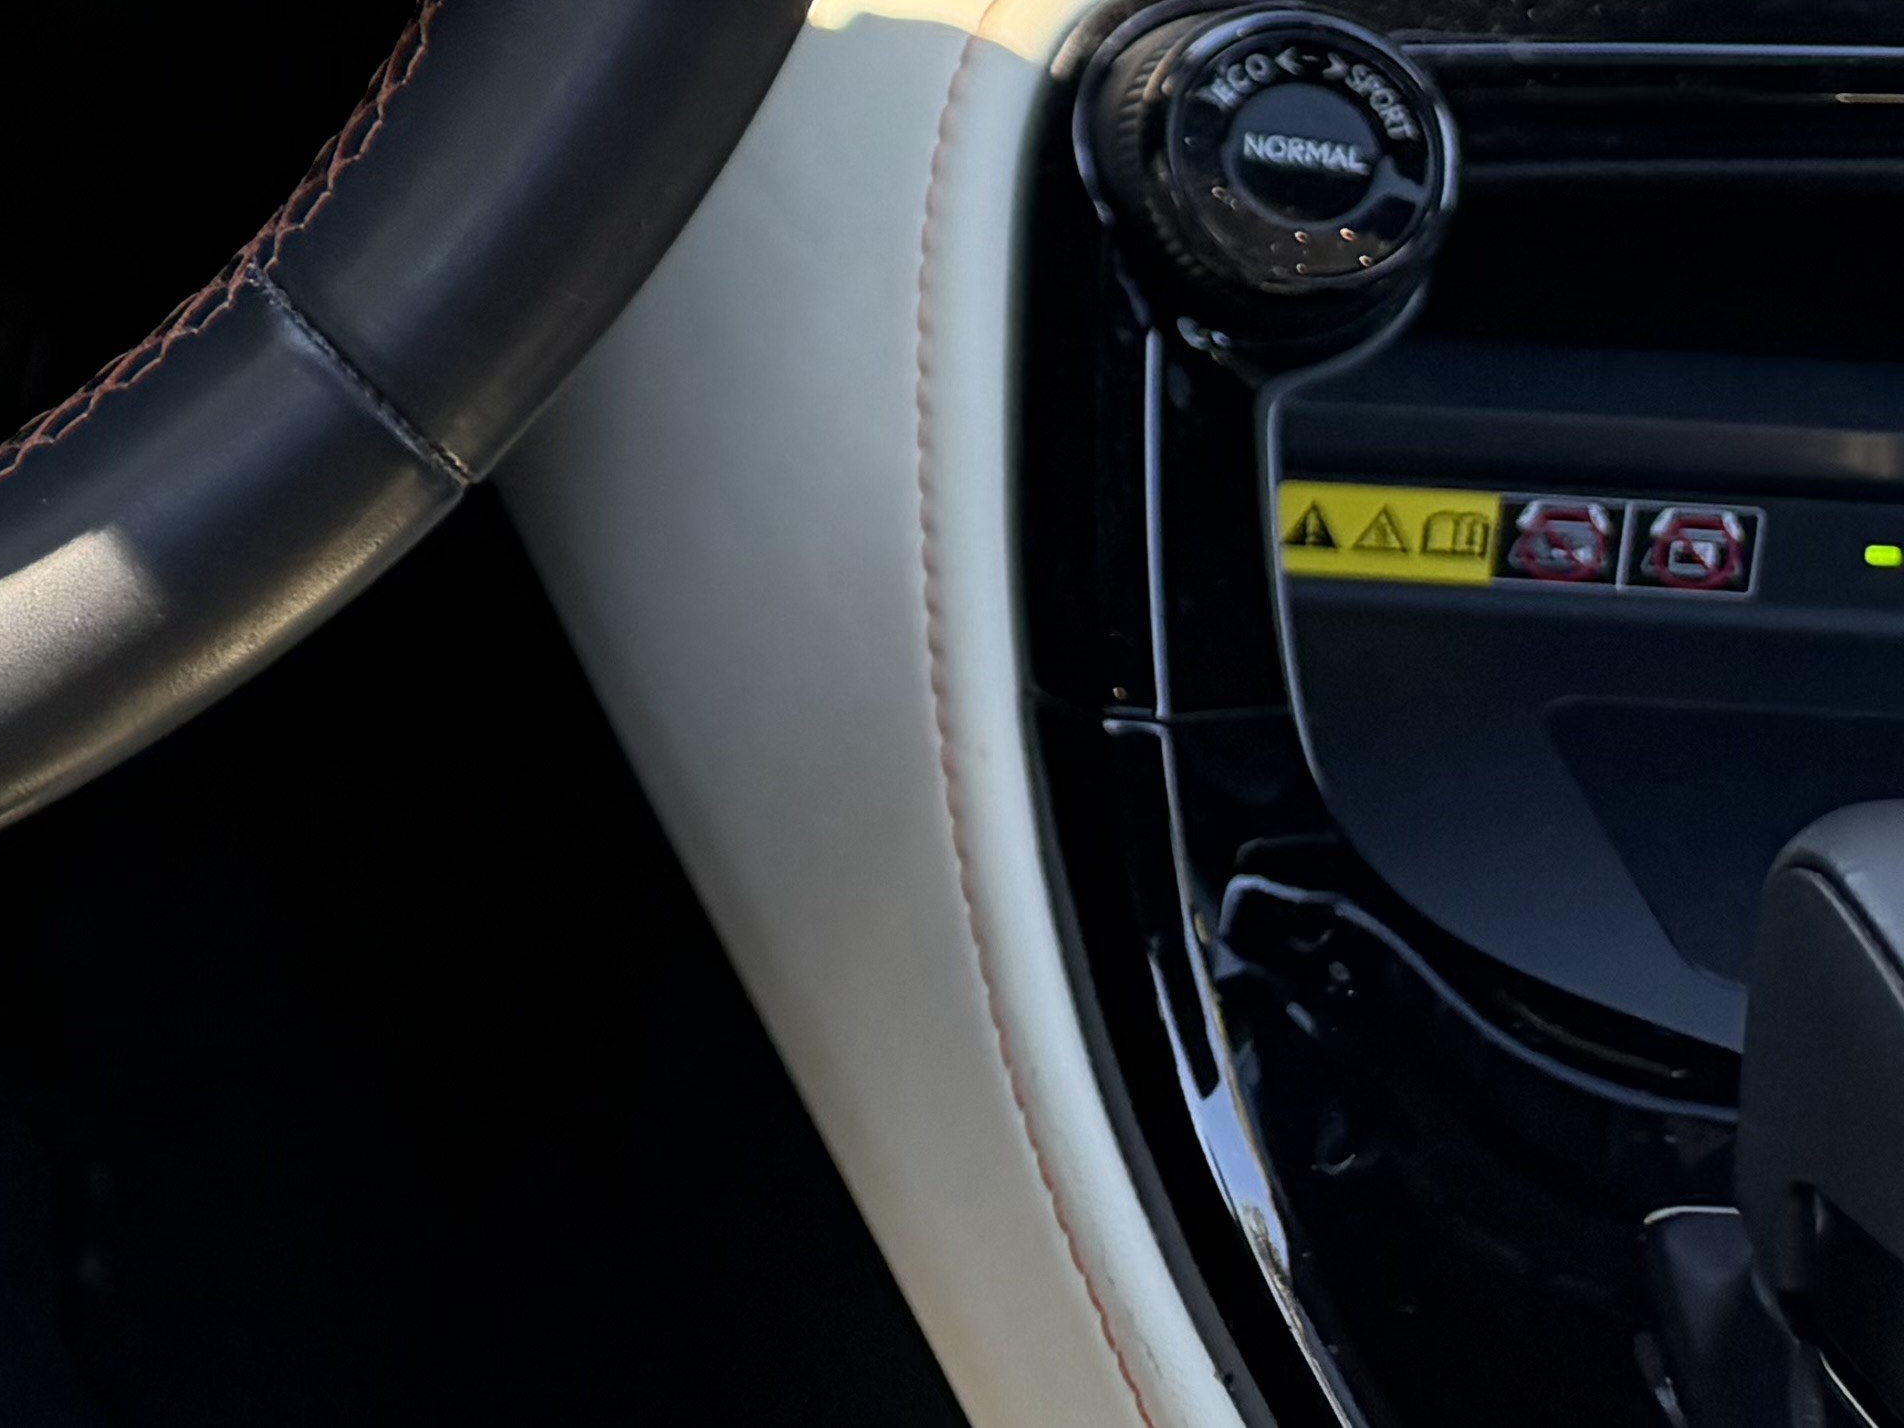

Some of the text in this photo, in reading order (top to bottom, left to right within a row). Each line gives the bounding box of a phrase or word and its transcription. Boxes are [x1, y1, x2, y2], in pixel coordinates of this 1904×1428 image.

[1209, 52, 1275, 108] ECO
[1344, 63, 1420, 141] SPORT
[1243, 131, 1371, 176] NORMAL
